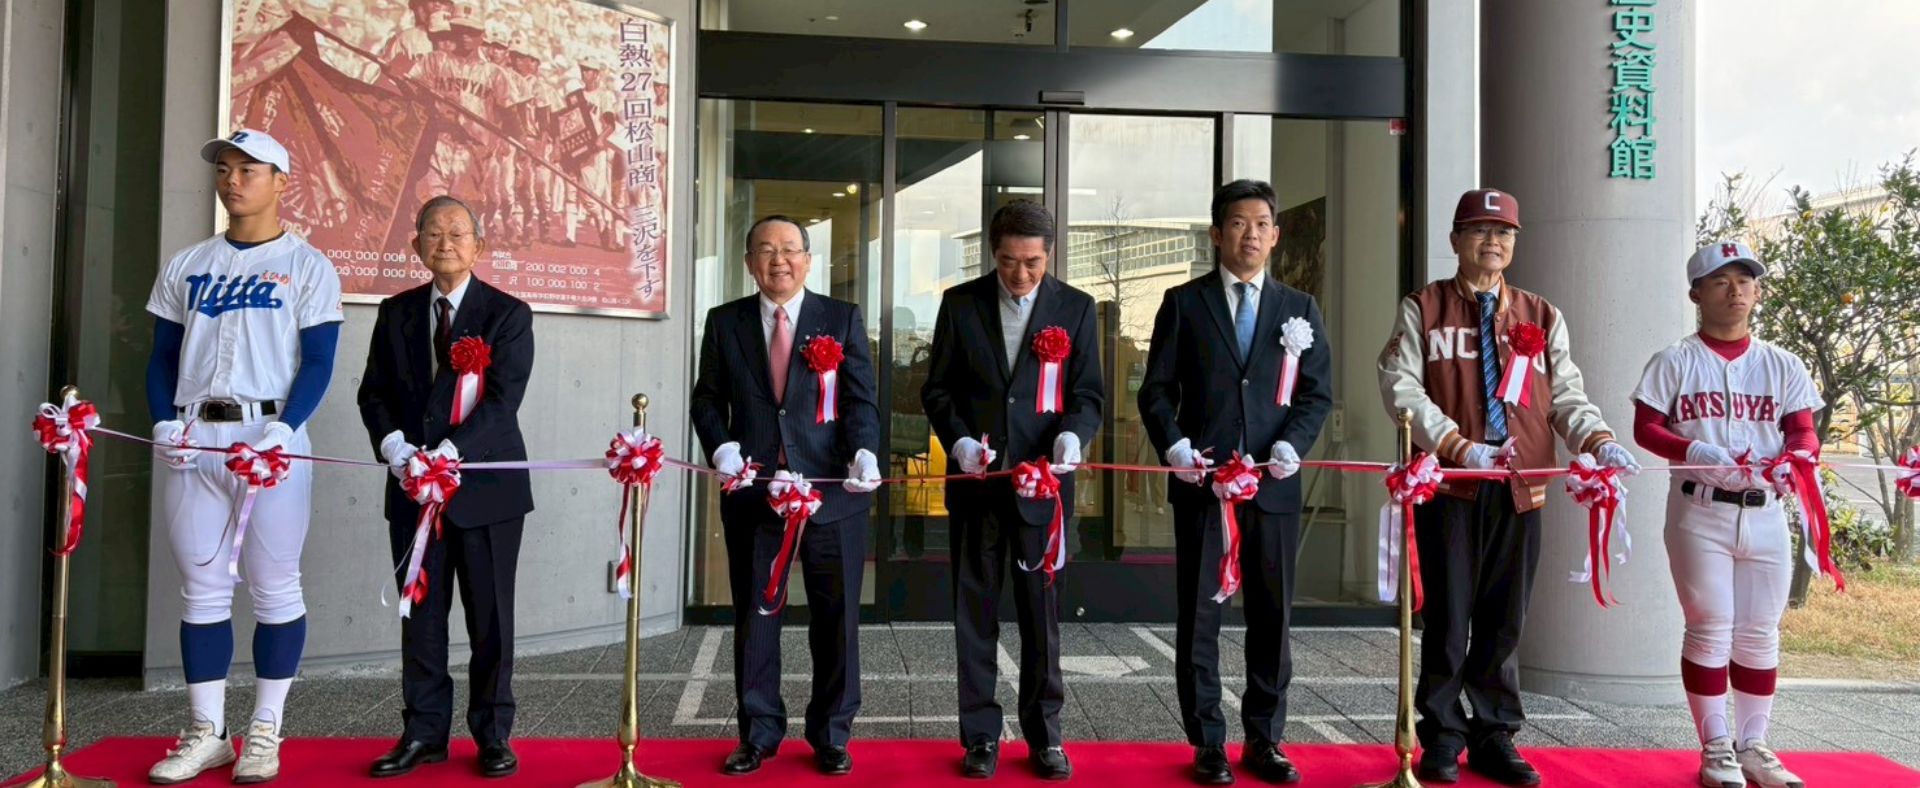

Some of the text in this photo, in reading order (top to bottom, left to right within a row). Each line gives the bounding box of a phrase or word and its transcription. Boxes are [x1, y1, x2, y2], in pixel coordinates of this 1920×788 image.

[1611, 0, 1656, 179] 史資料館
[1484, 192, 1500, 210] C
[1721, 244, 1739, 258] M
[526, 262, 545, 272] 200
[570, 265, 588, 275] 000
[593, 268, 600, 276] 4
[527, 277, 545, 287] 100
[571, 279, 588, 290] 100
[593, 281, 600, 290] 2
[1669, 391, 1780, 424] ATSUYA
